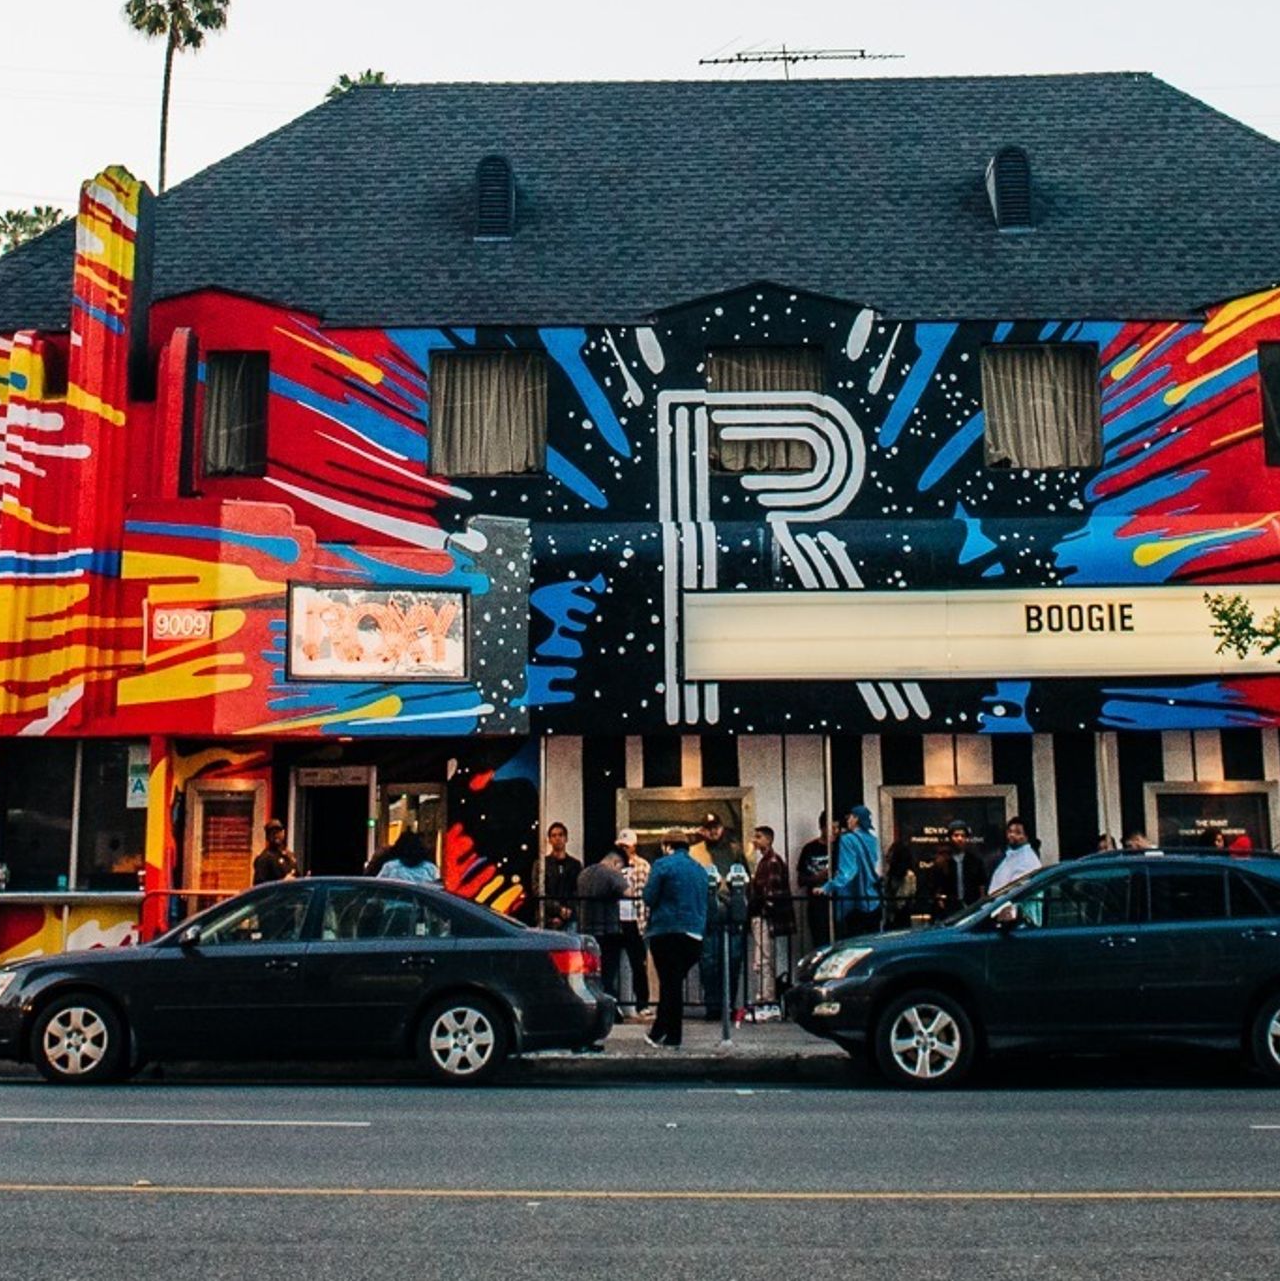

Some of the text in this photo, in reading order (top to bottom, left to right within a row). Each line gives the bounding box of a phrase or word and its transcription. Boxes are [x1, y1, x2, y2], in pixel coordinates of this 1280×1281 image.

[156, 612, 207, 636] 9009
[302, 600, 458, 663] ROXY
[1025, 603, 1135, 633] BOOGIE
[131, 778, 146, 794] A
